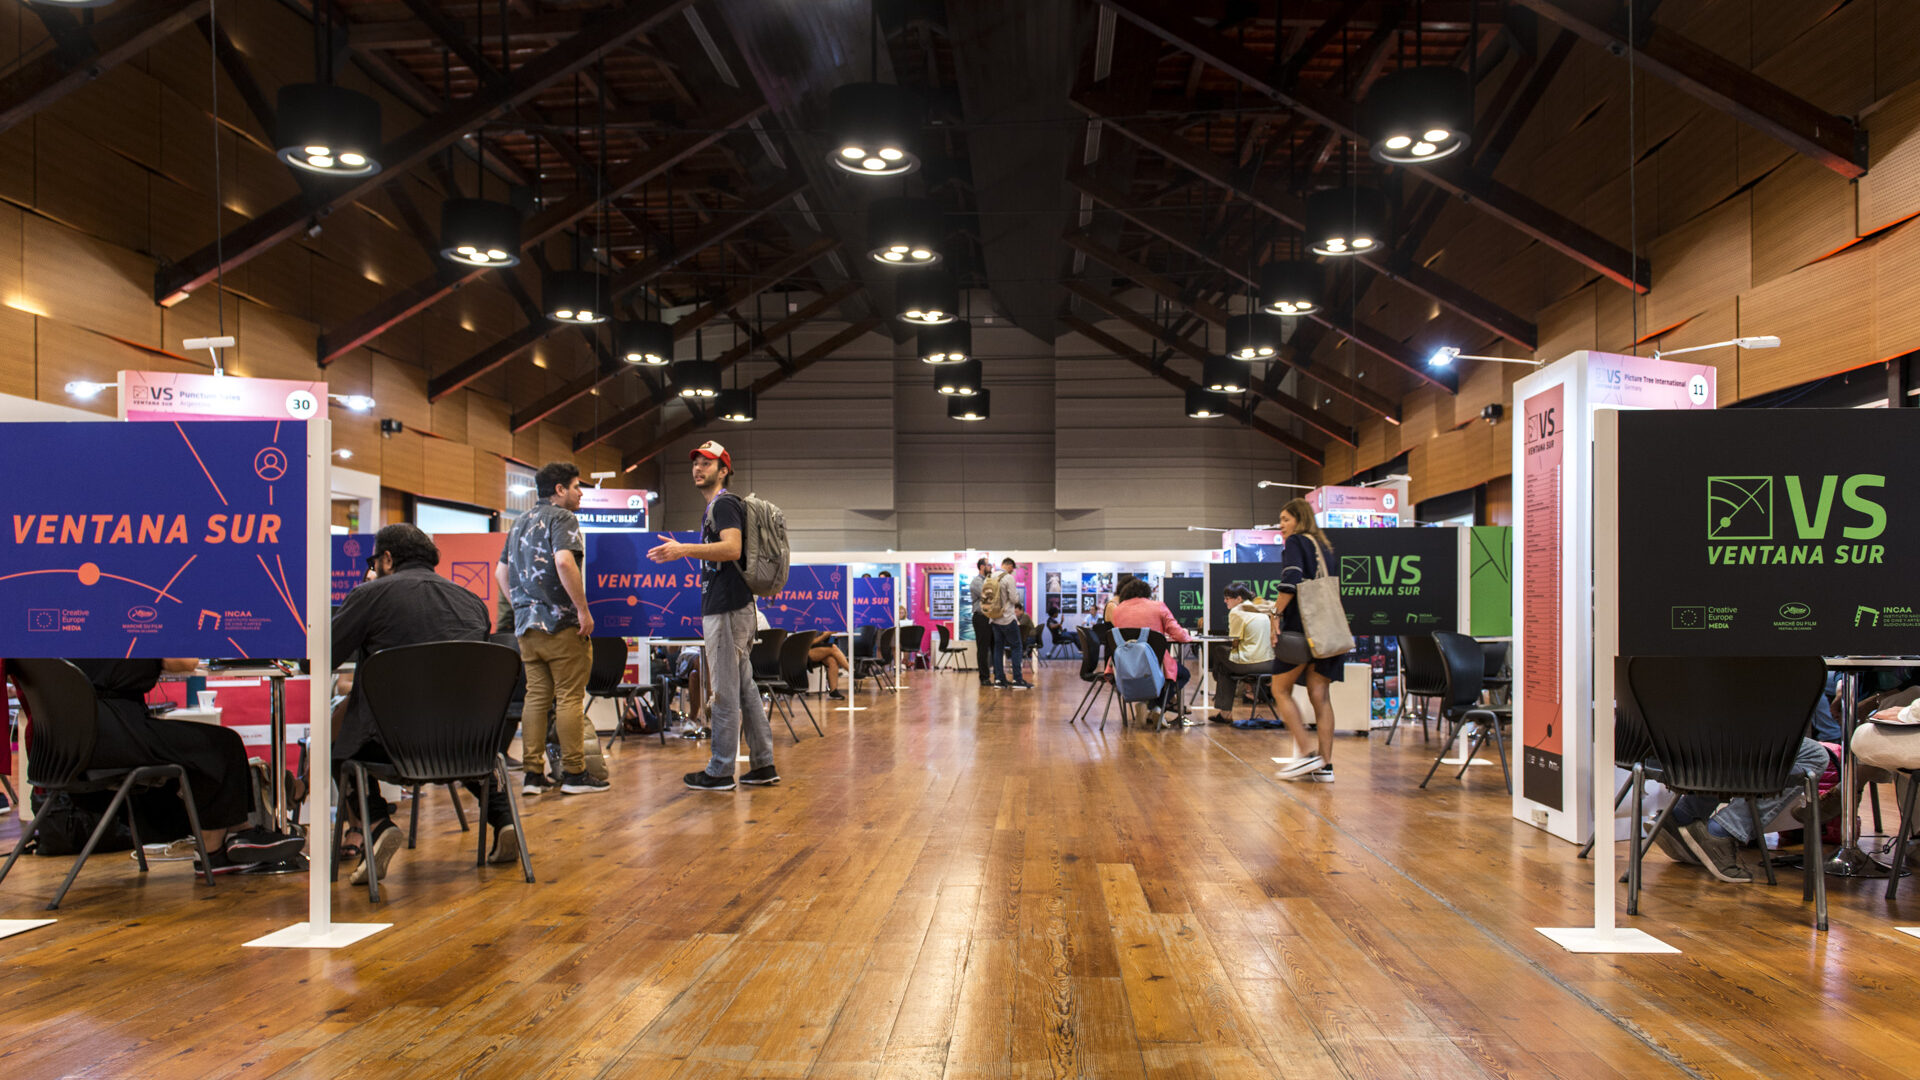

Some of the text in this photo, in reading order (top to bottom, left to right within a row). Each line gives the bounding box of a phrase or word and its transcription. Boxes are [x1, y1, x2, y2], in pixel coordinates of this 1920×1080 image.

[1607, 369, 1621, 384] VS
[1624, 374, 1686, 387] Picture Tree International
[150, 387, 173, 400] VS
[1693, 384, 1704, 395] 11
[292, 399, 310, 410] 30
[1539, 408, 1555, 439] VS
[1785, 473, 1888, 540] VS
[595, 514, 638, 523] REPUBLIC
[12, 514, 282, 544] VENTANA SUR
[1708, 544, 1885, 566] VENTANA SUR
[1375, 555, 1422, 585] VS
[597, 574, 678, 588] VENTANA
[816, 590, 840, 600] SUR
[1341, 586, 1421, 596] VENTANA SUR
[871, 597, 889, 605] SUR
